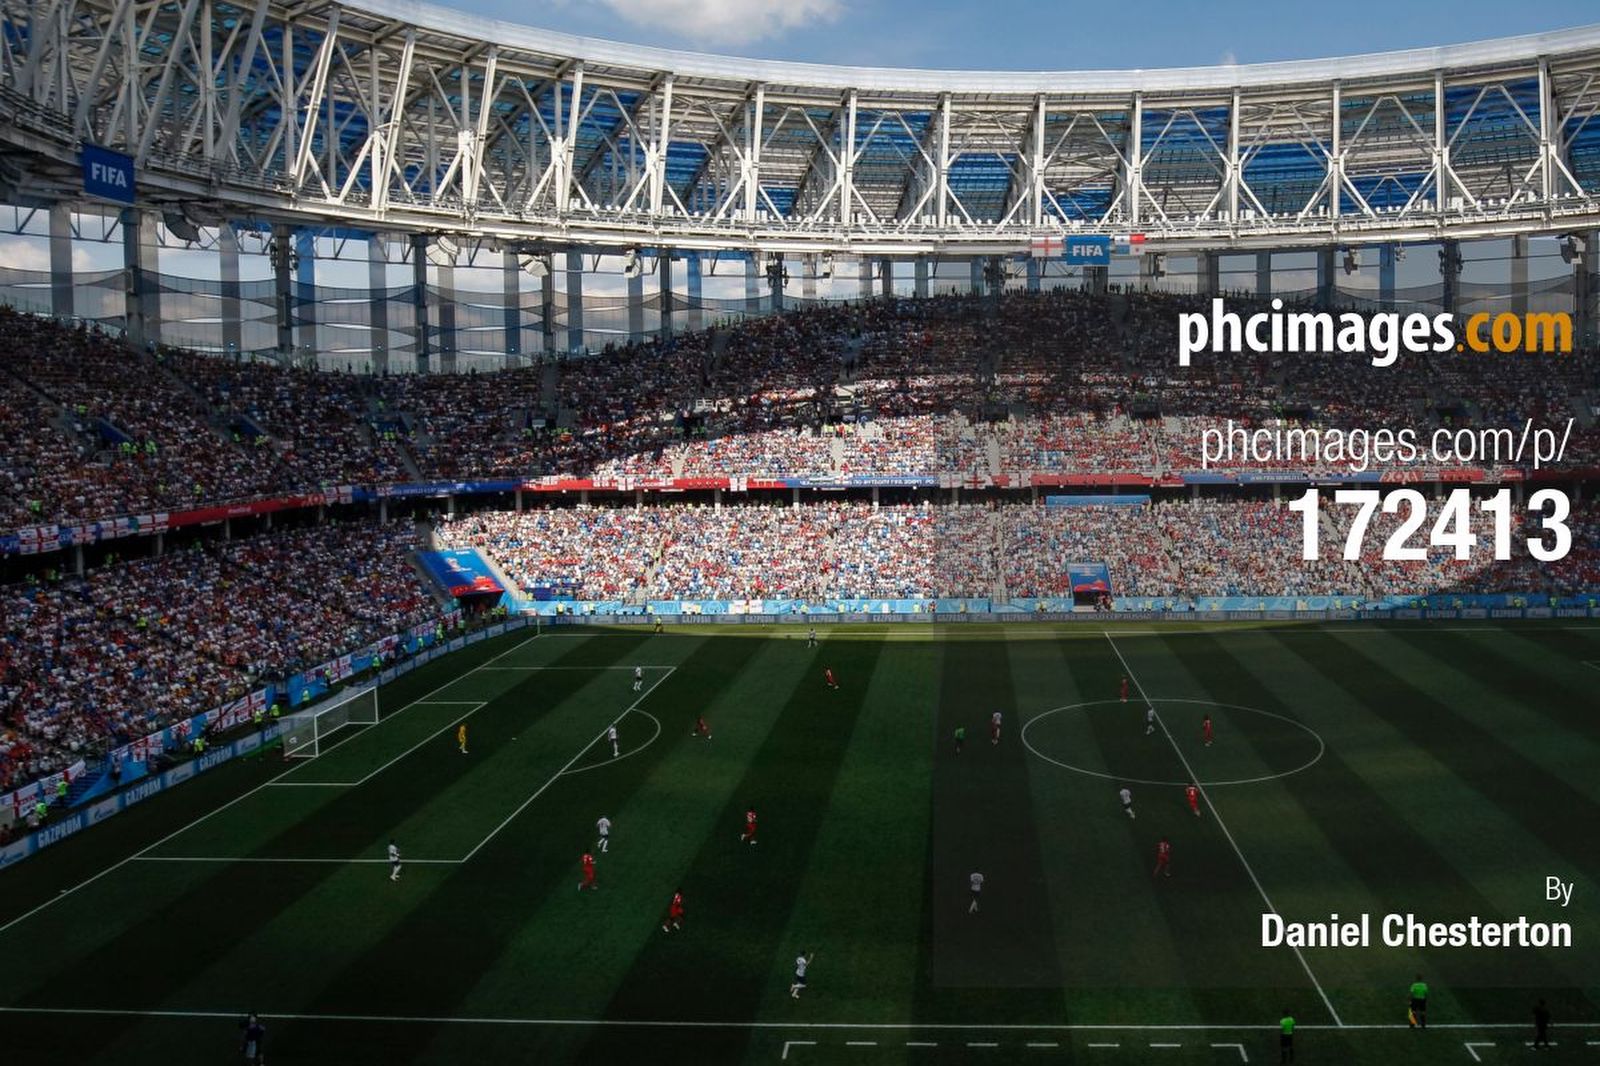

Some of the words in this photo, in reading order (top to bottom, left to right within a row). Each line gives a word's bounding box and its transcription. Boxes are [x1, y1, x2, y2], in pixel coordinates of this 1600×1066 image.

[91, 162, 127, 188] FIFA
[1072, 245, 1103, 257] FIFA
[38, 813, 82, 848] GAZPROM
